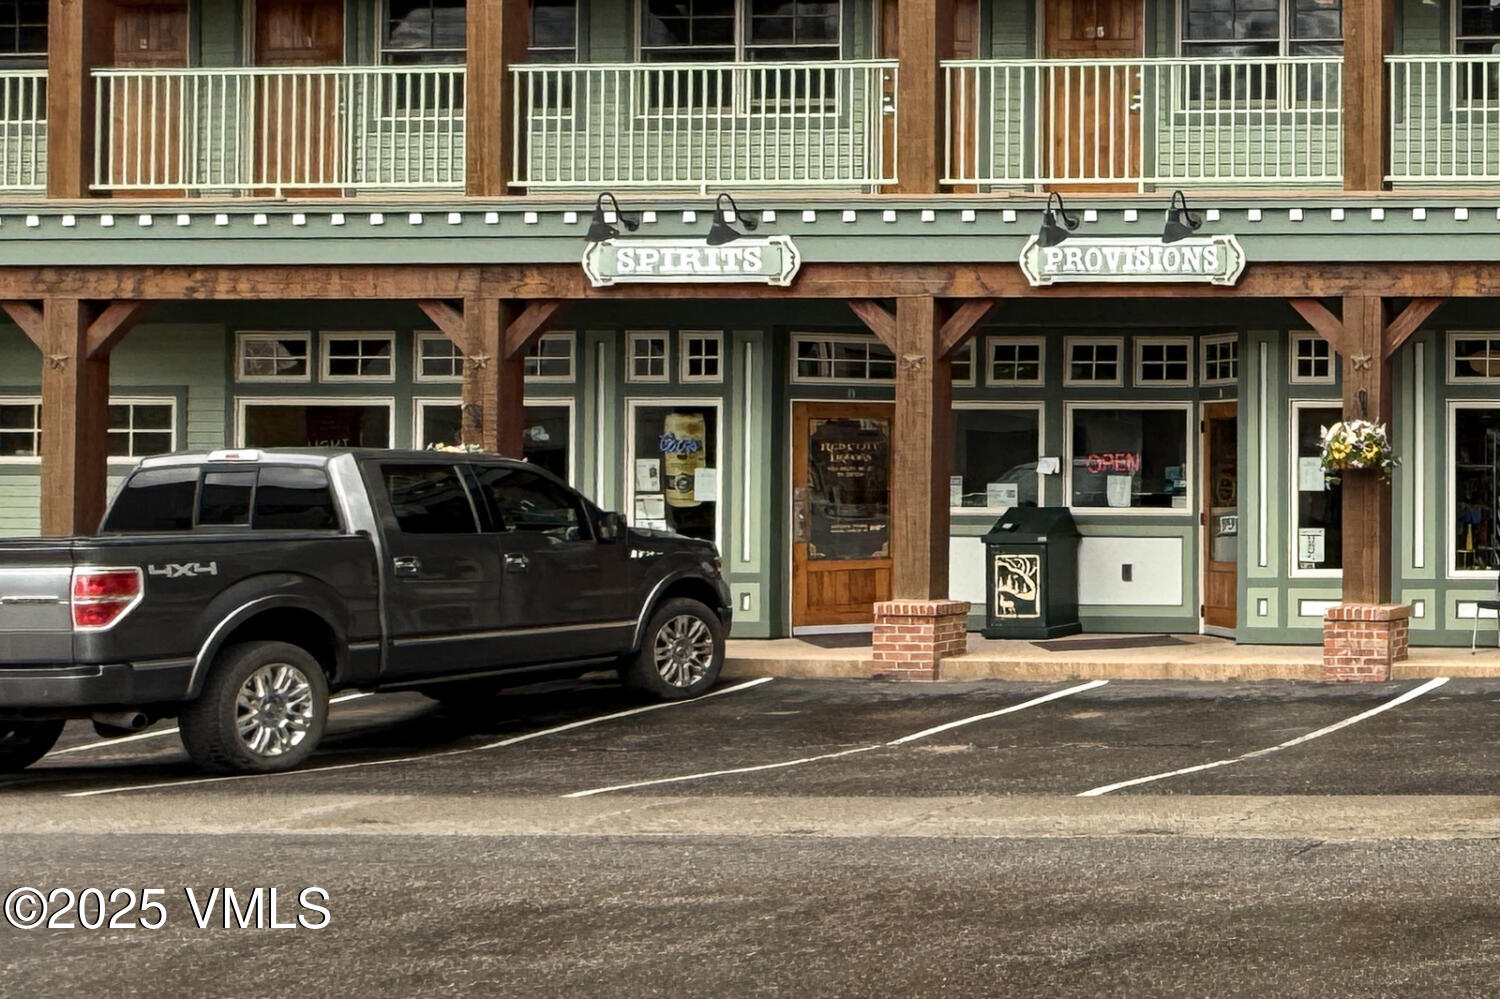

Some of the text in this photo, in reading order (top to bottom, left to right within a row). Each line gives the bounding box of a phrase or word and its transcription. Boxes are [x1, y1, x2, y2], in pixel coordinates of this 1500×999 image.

[616, 247, 763, 273] SPIRITS
[1044, 246, 1219, 272] PROVISIONS
[1086, 453, 1141, 473] OPEN
